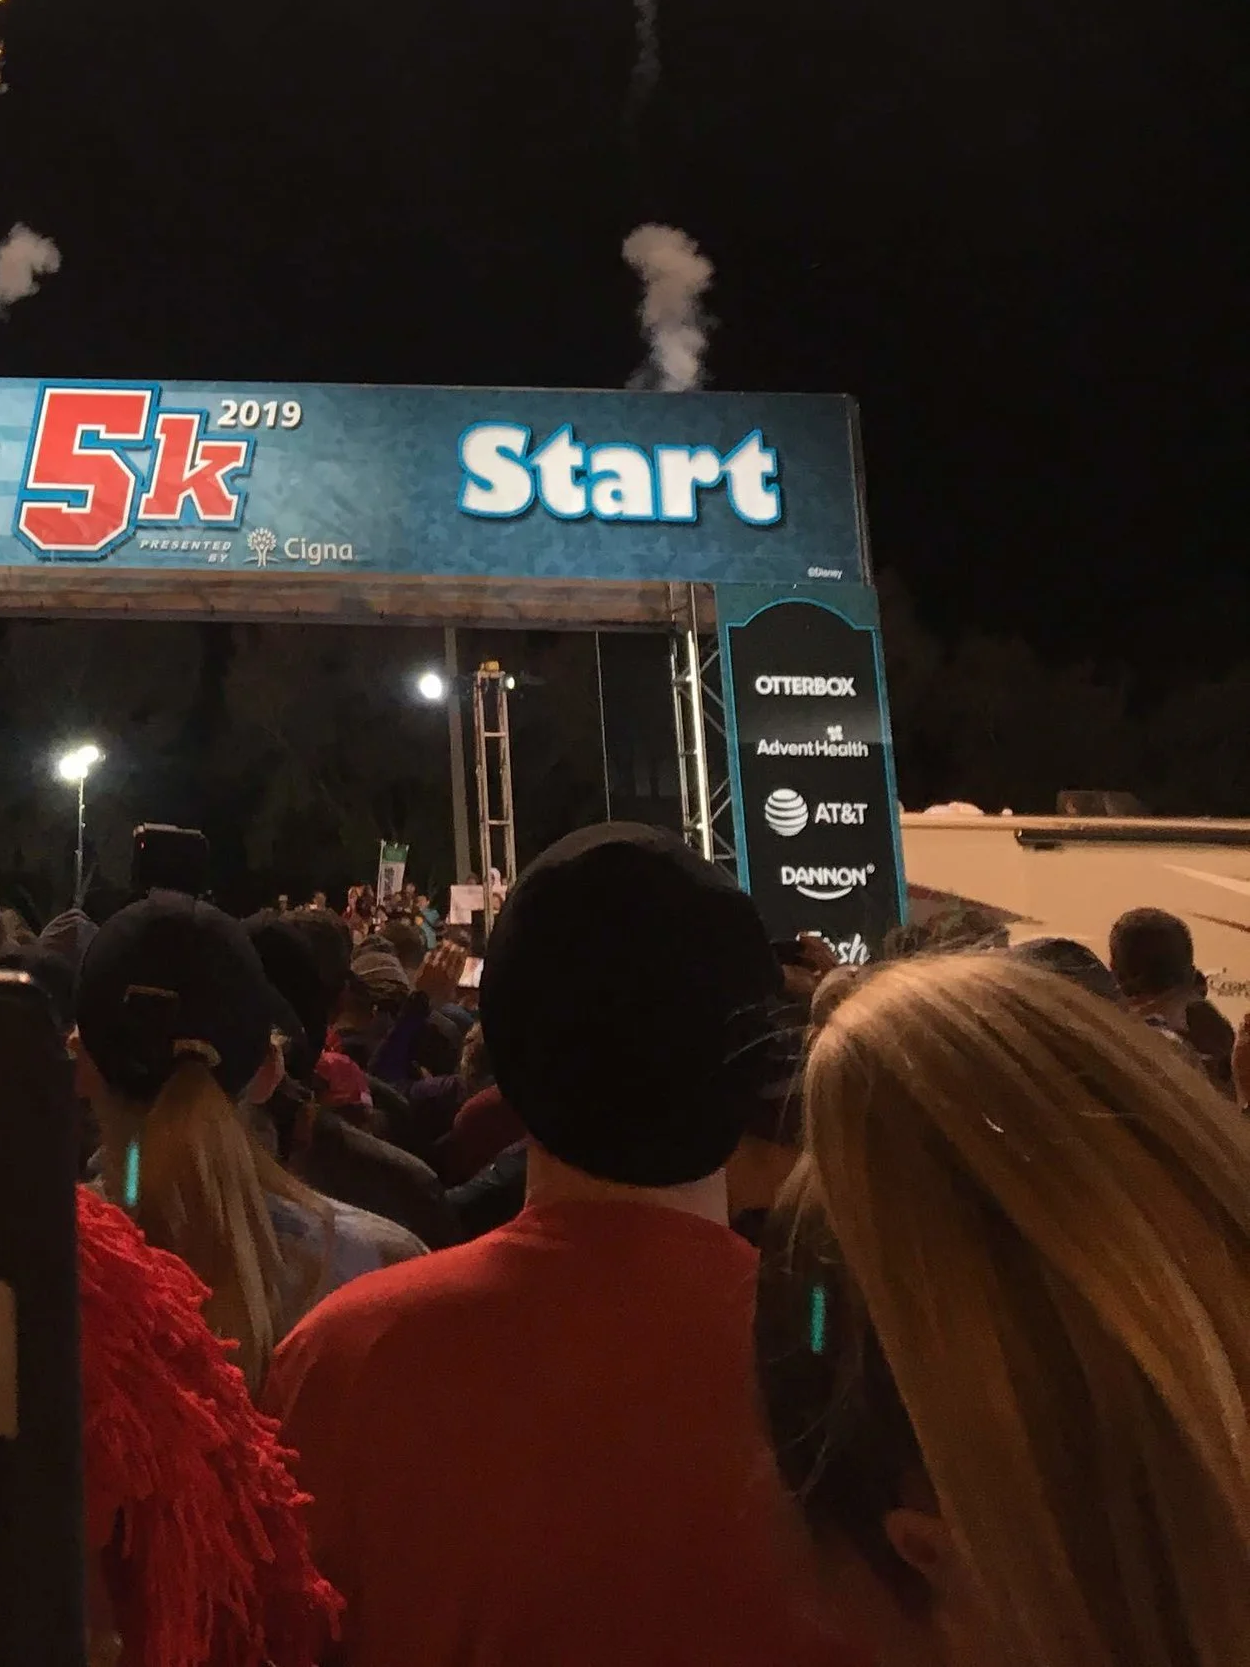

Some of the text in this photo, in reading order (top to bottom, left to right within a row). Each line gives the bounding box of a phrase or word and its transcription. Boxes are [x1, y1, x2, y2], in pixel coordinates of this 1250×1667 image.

[217, 400, 302, 428] 2019
[458, 420, 782, 525] Start
[139, 539, 232, 551] PRESENTED
[283, 537, 354, 565] Cigna
[207, 553, 229, 563] BY
[755, 675, 857, 696] OTTERBOX
[813, 803, 868, 825] AT&T
